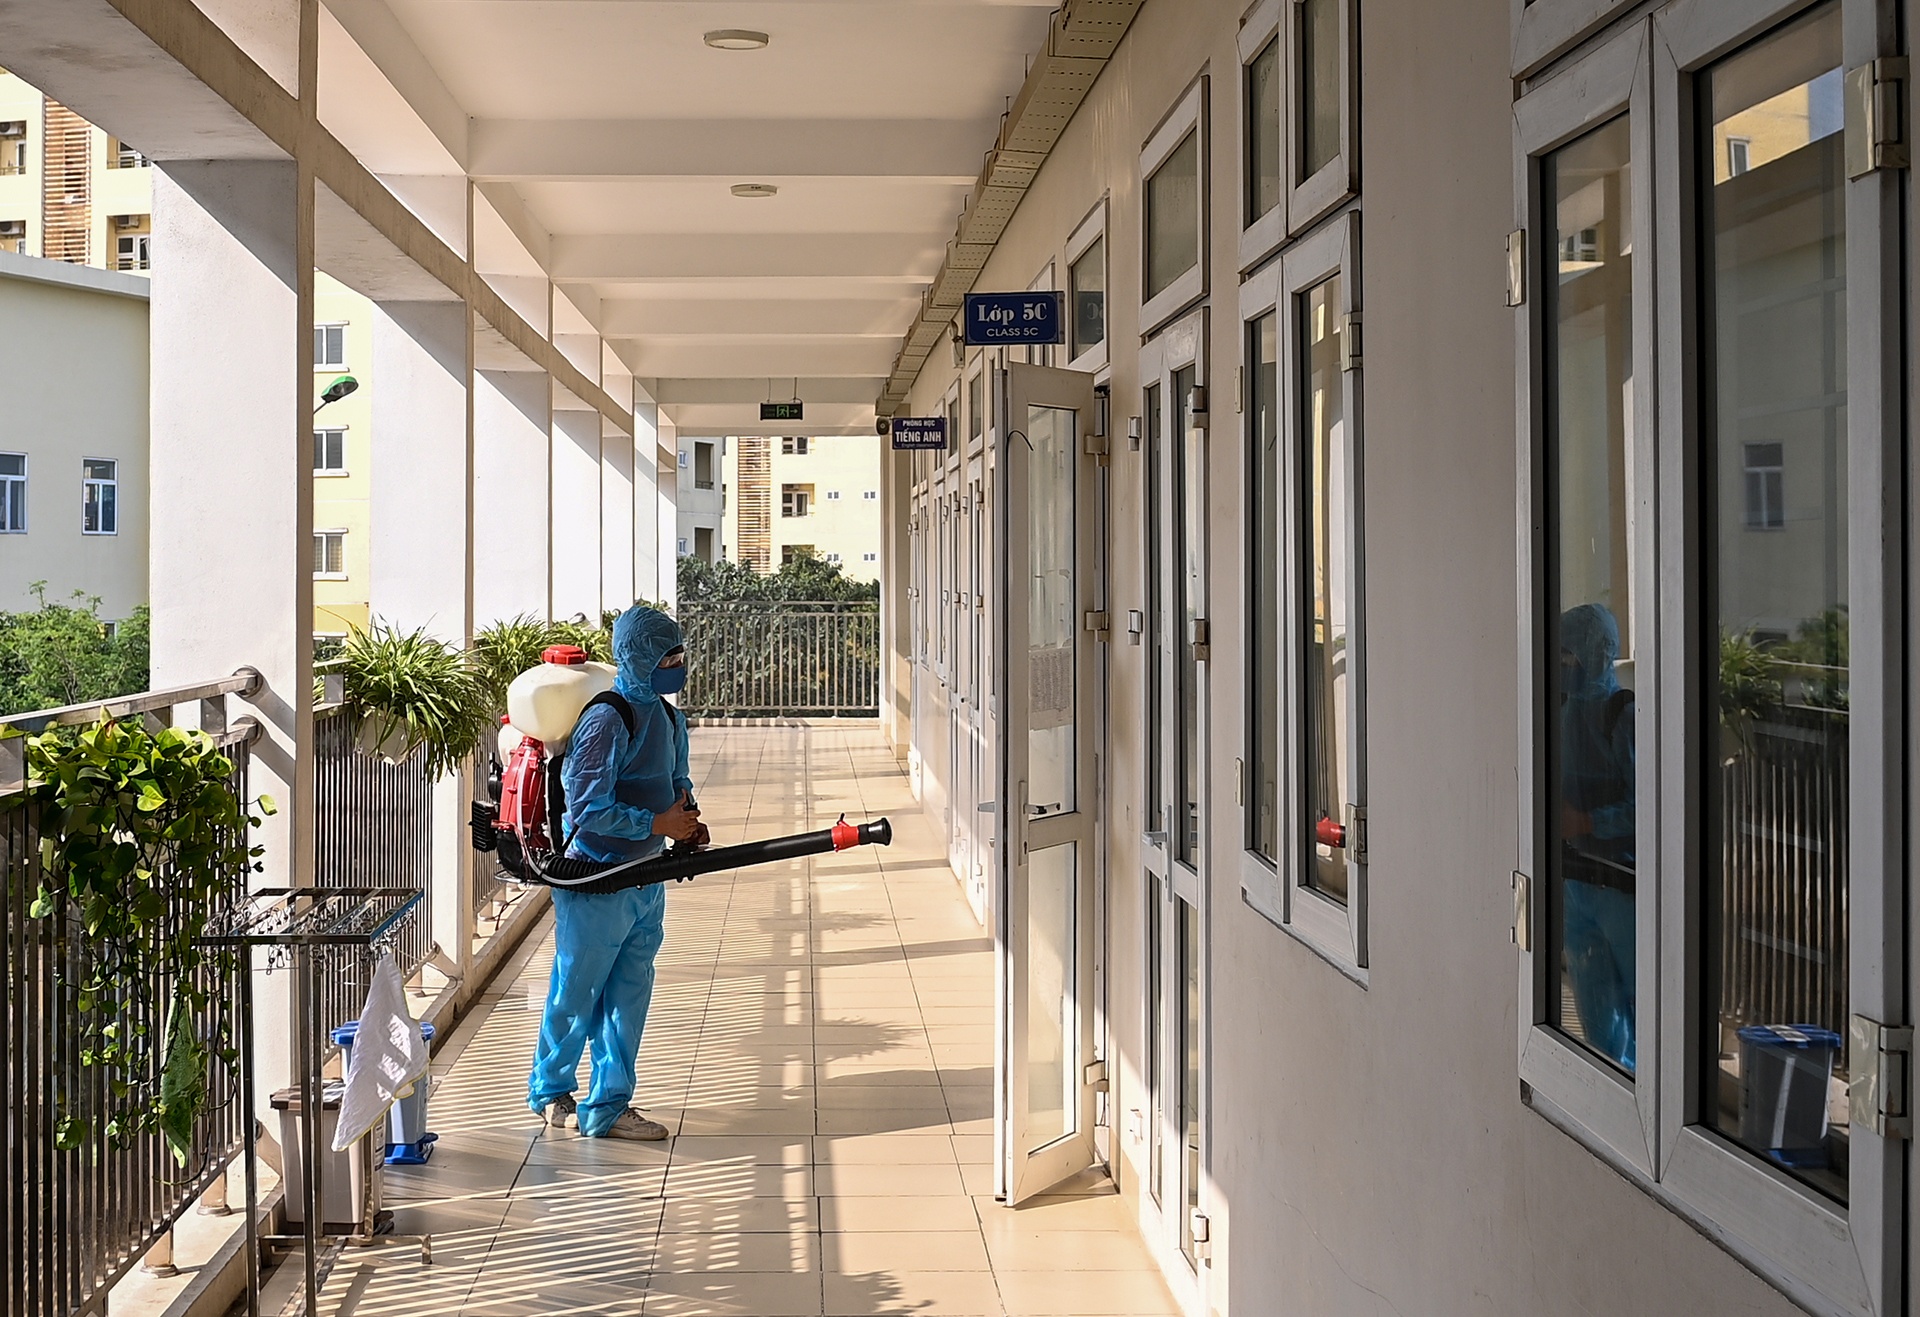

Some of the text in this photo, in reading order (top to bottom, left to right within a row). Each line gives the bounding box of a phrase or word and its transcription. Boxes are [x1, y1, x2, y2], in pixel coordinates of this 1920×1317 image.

[977, 302, 1047, 325] Lớp 5C
[986, 327, 1039, 337] CLASS 5C
[922, 431, 942, 443] ANH
